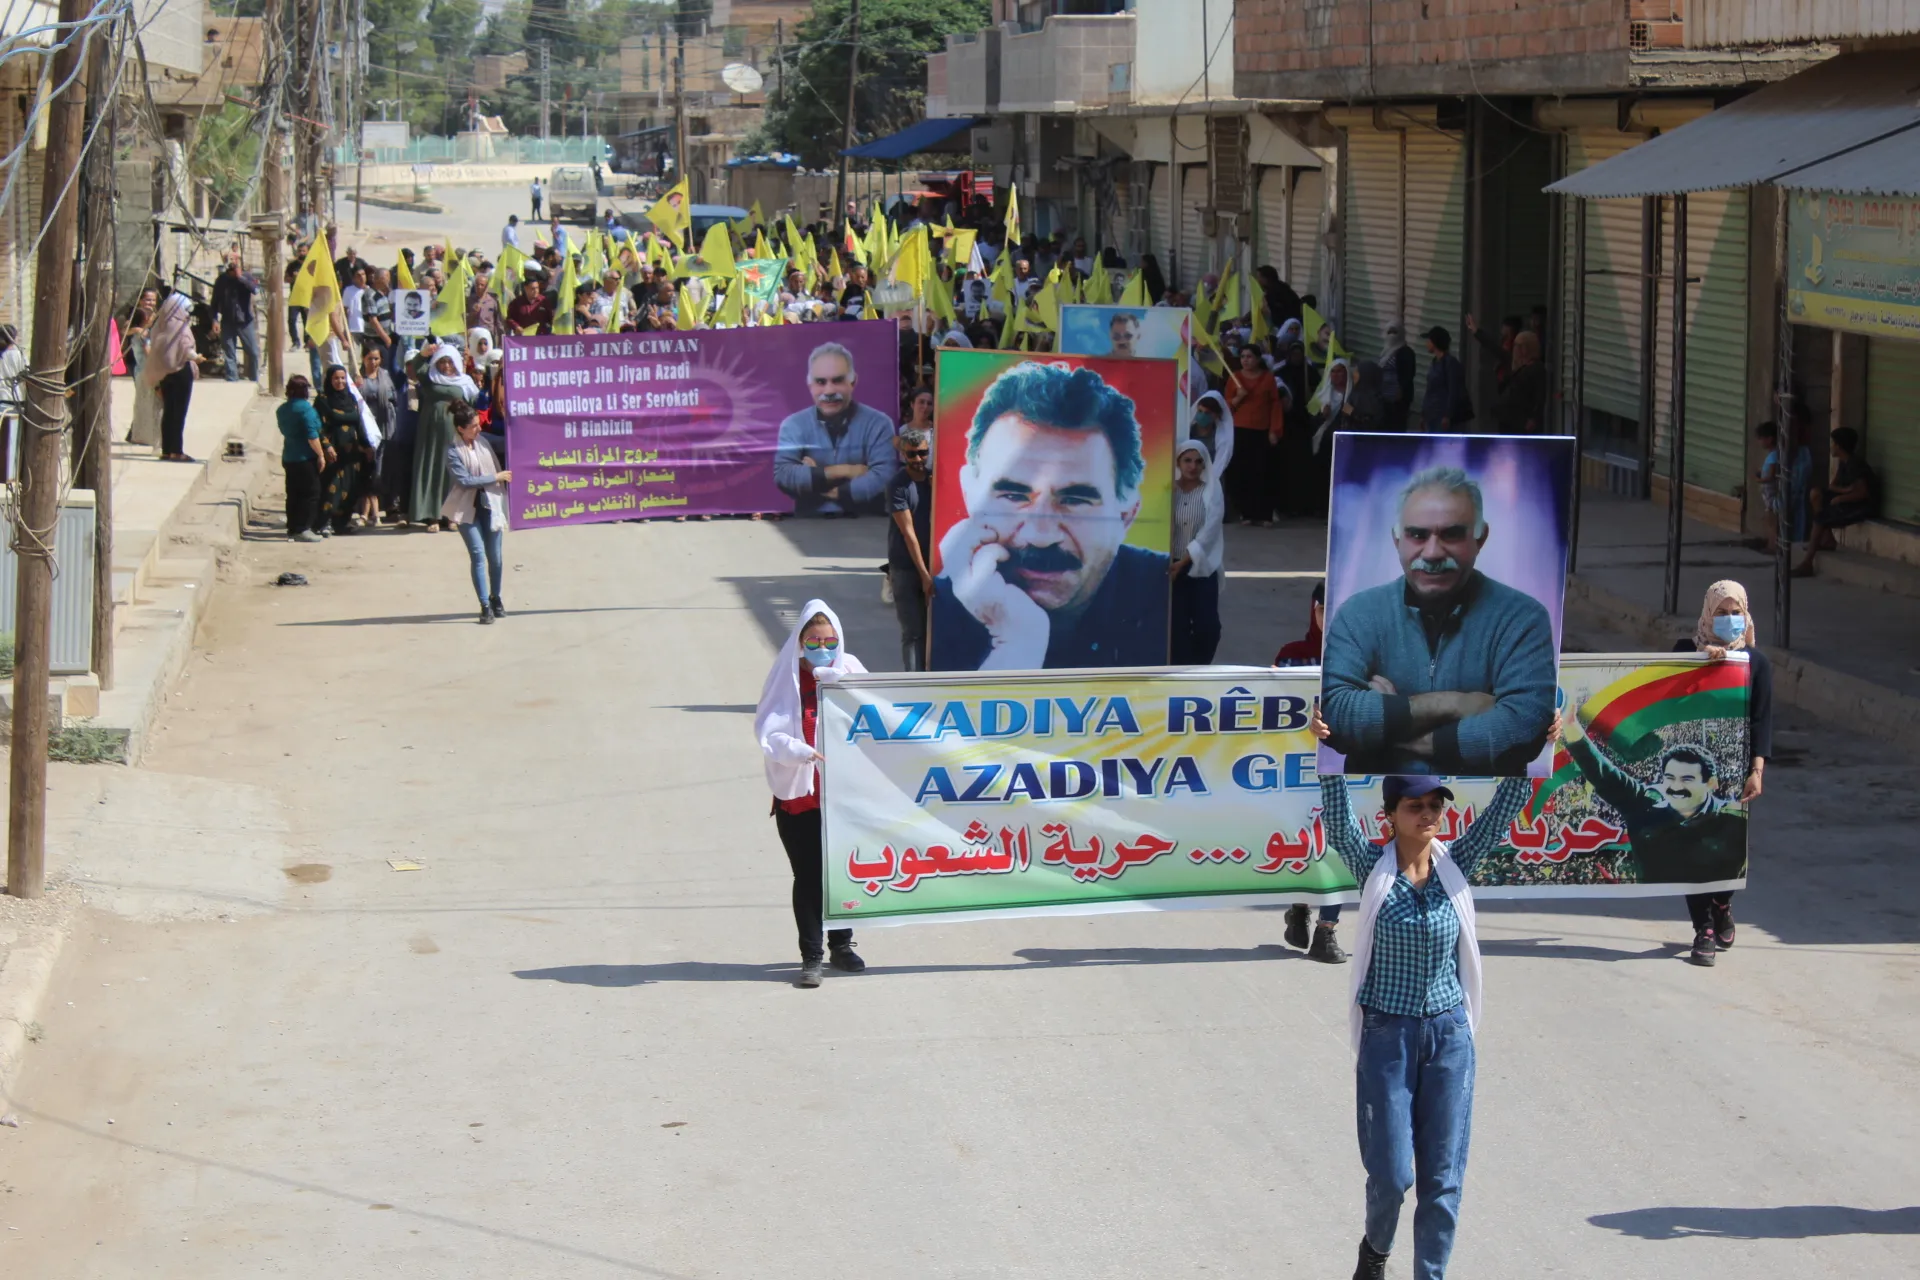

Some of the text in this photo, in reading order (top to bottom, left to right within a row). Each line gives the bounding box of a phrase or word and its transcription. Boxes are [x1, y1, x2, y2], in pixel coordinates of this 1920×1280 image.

[509, 339, 699, 361] BI RUHÊ JINÊ CIWAN
[514, 361, 690, 388] Bi Durşmeya Jin Jiyan Azadî
[510, 388, 699, 416] Emê Kompiloya Li Ser Serokatî
[565, 420, 633, 438] Bi Binbixin
[538, 443, 658, 469] بروح المرأة الشابة
[528, 479, 554, 496] حرة
[557, 475, 589, 492] حياة
[593, 468, 633, 488] المرأة
[636, 469, 675, 487] بشعار
[560, 500, 585, 518] على
[847, 686, 1320, 742] AZADIYA RÊB
[915, 757, 1209, 804] AZADIYA
[1041, 822, 1176, 882] حرية
[1254, 806, 1325, 873] آبو
[847, 820, 1030, 895] الشعوب
